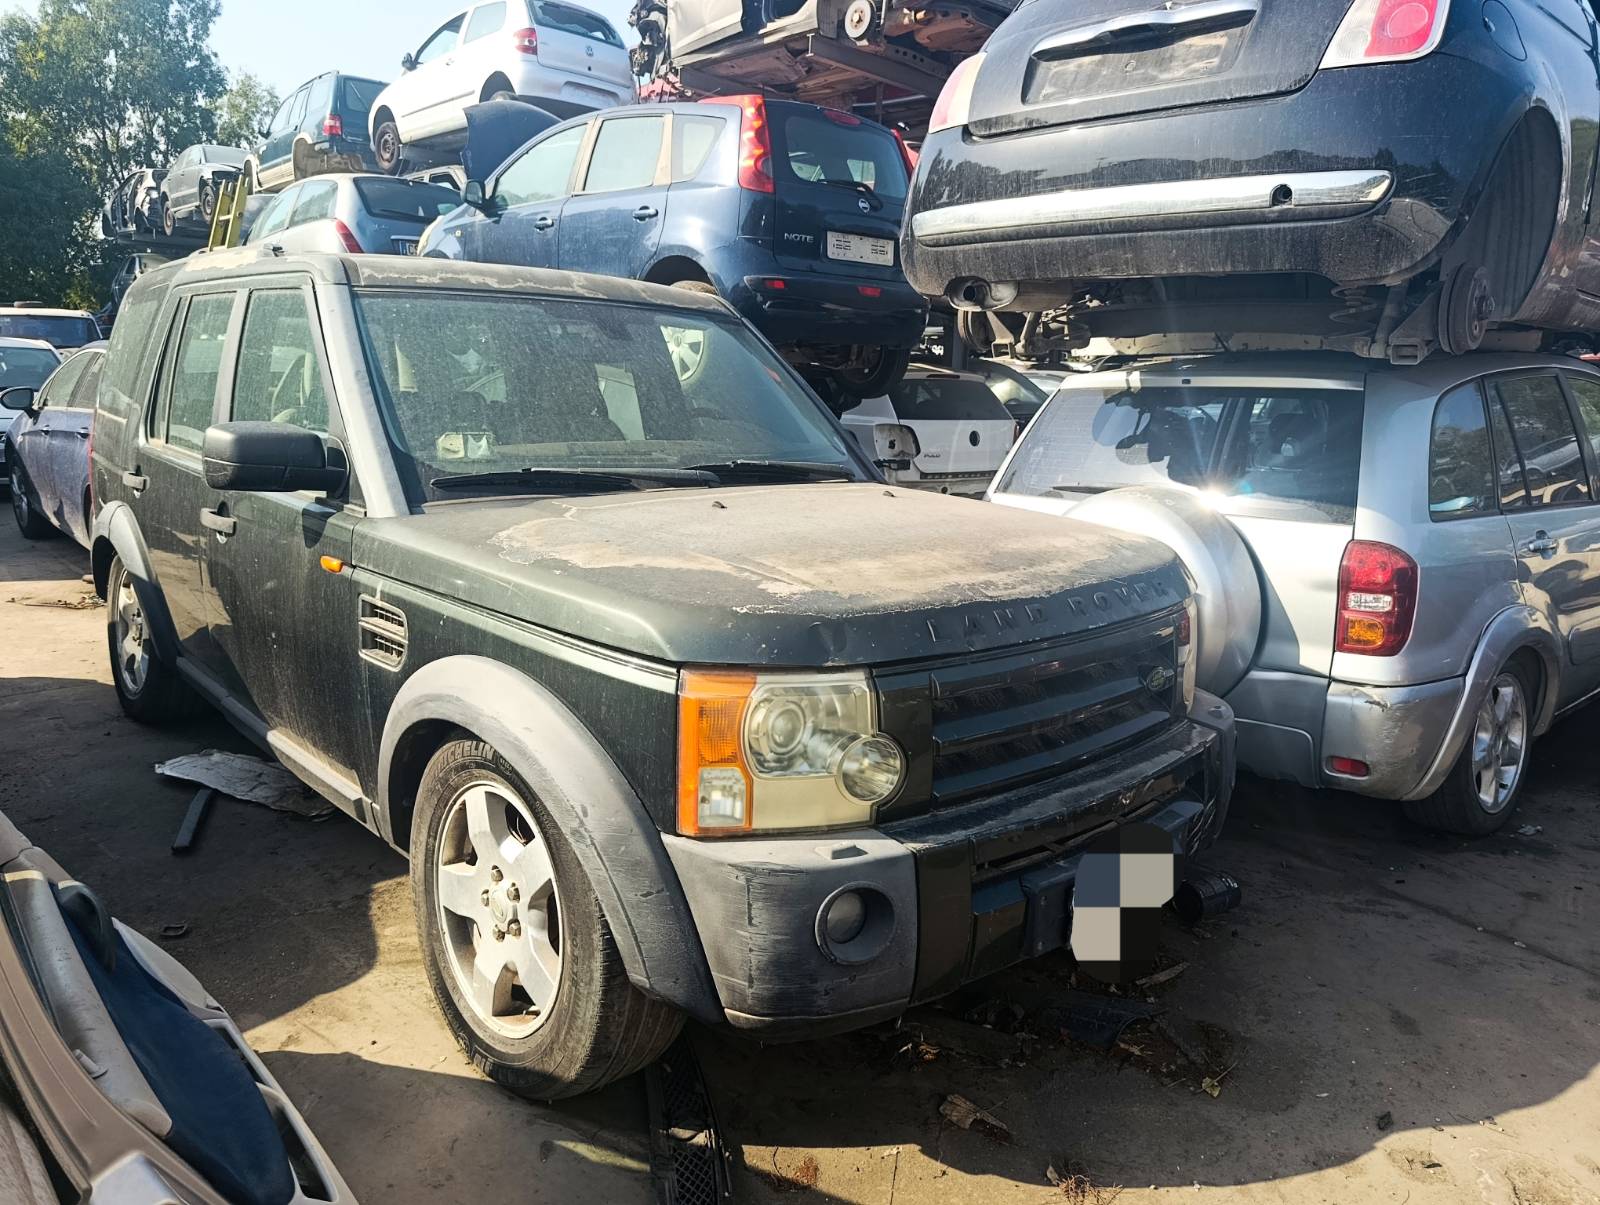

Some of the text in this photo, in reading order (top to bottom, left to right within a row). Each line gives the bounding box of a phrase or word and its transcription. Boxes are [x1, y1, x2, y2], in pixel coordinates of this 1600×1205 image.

[784, 233, 814, 242] NOTE
[926, 581, 1169, 643] LAND ROVER
